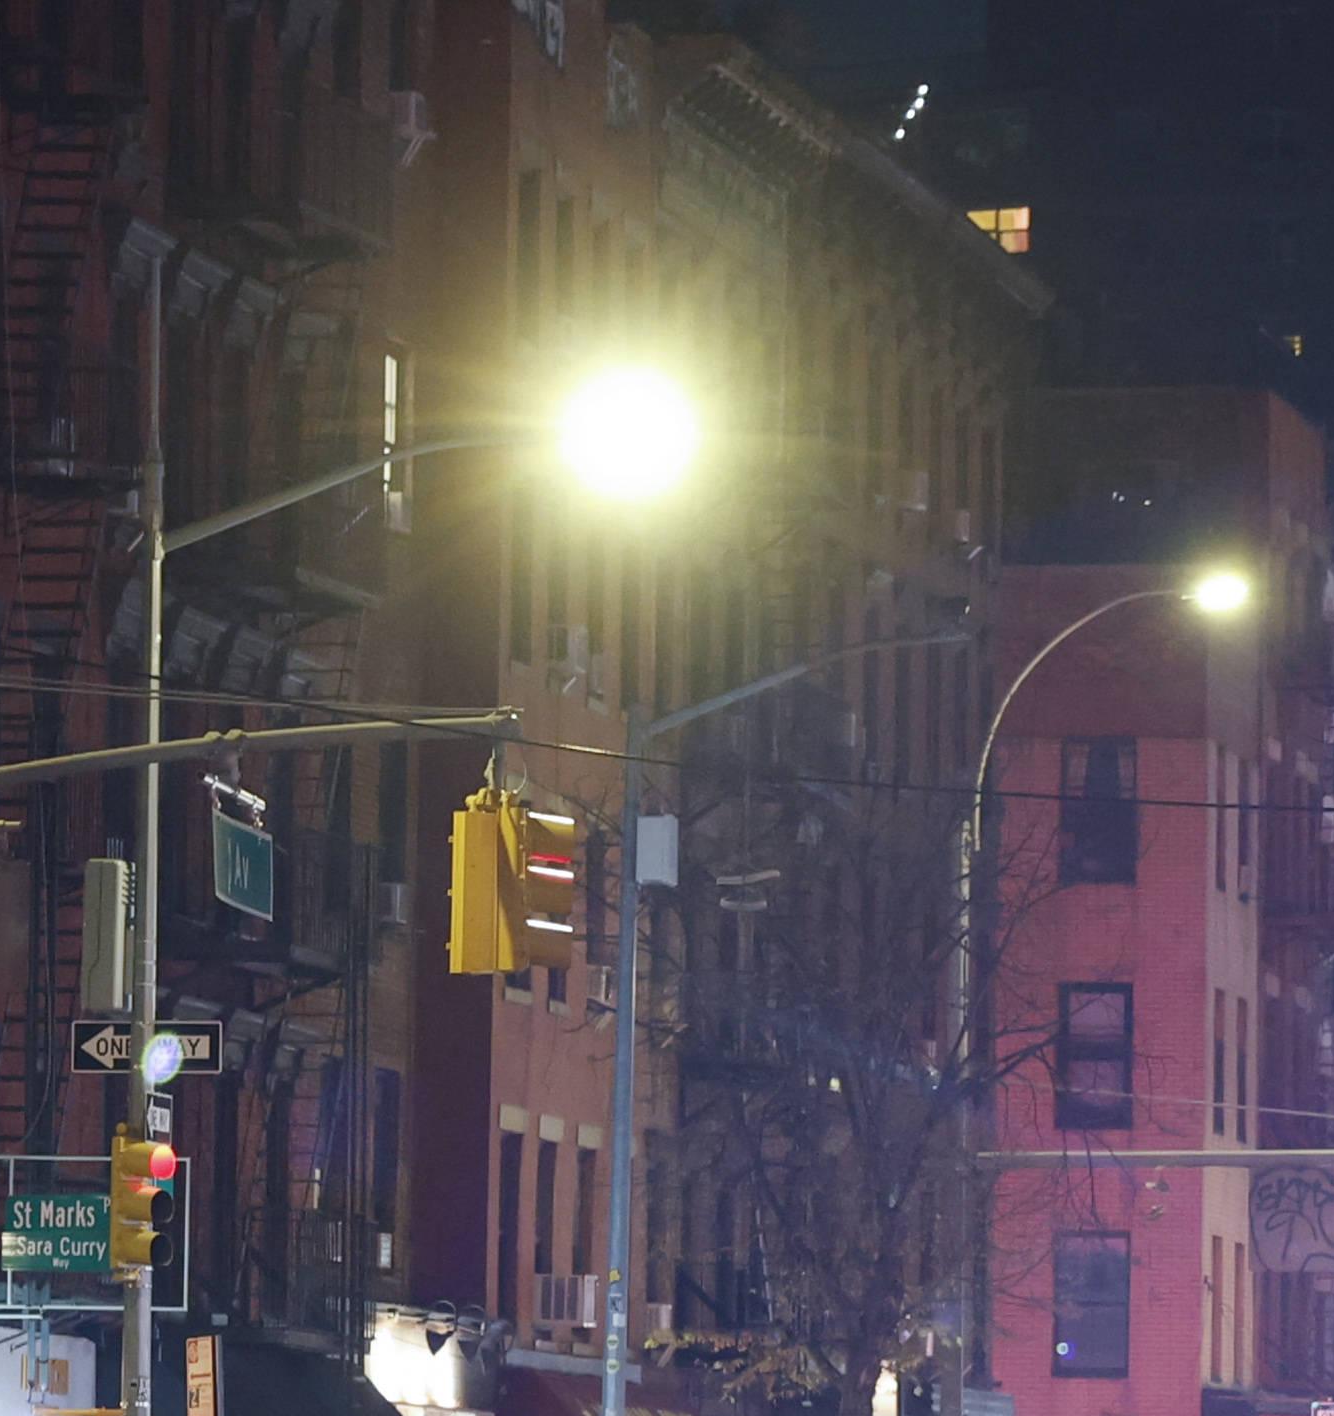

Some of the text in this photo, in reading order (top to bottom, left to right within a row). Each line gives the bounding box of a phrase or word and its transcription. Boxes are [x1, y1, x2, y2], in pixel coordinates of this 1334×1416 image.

[13, 1197, 111, 1229] St Marks P
[17, 1236, 106, 1261] Sara Curry
[52, 1258, 70, 1270] Way
